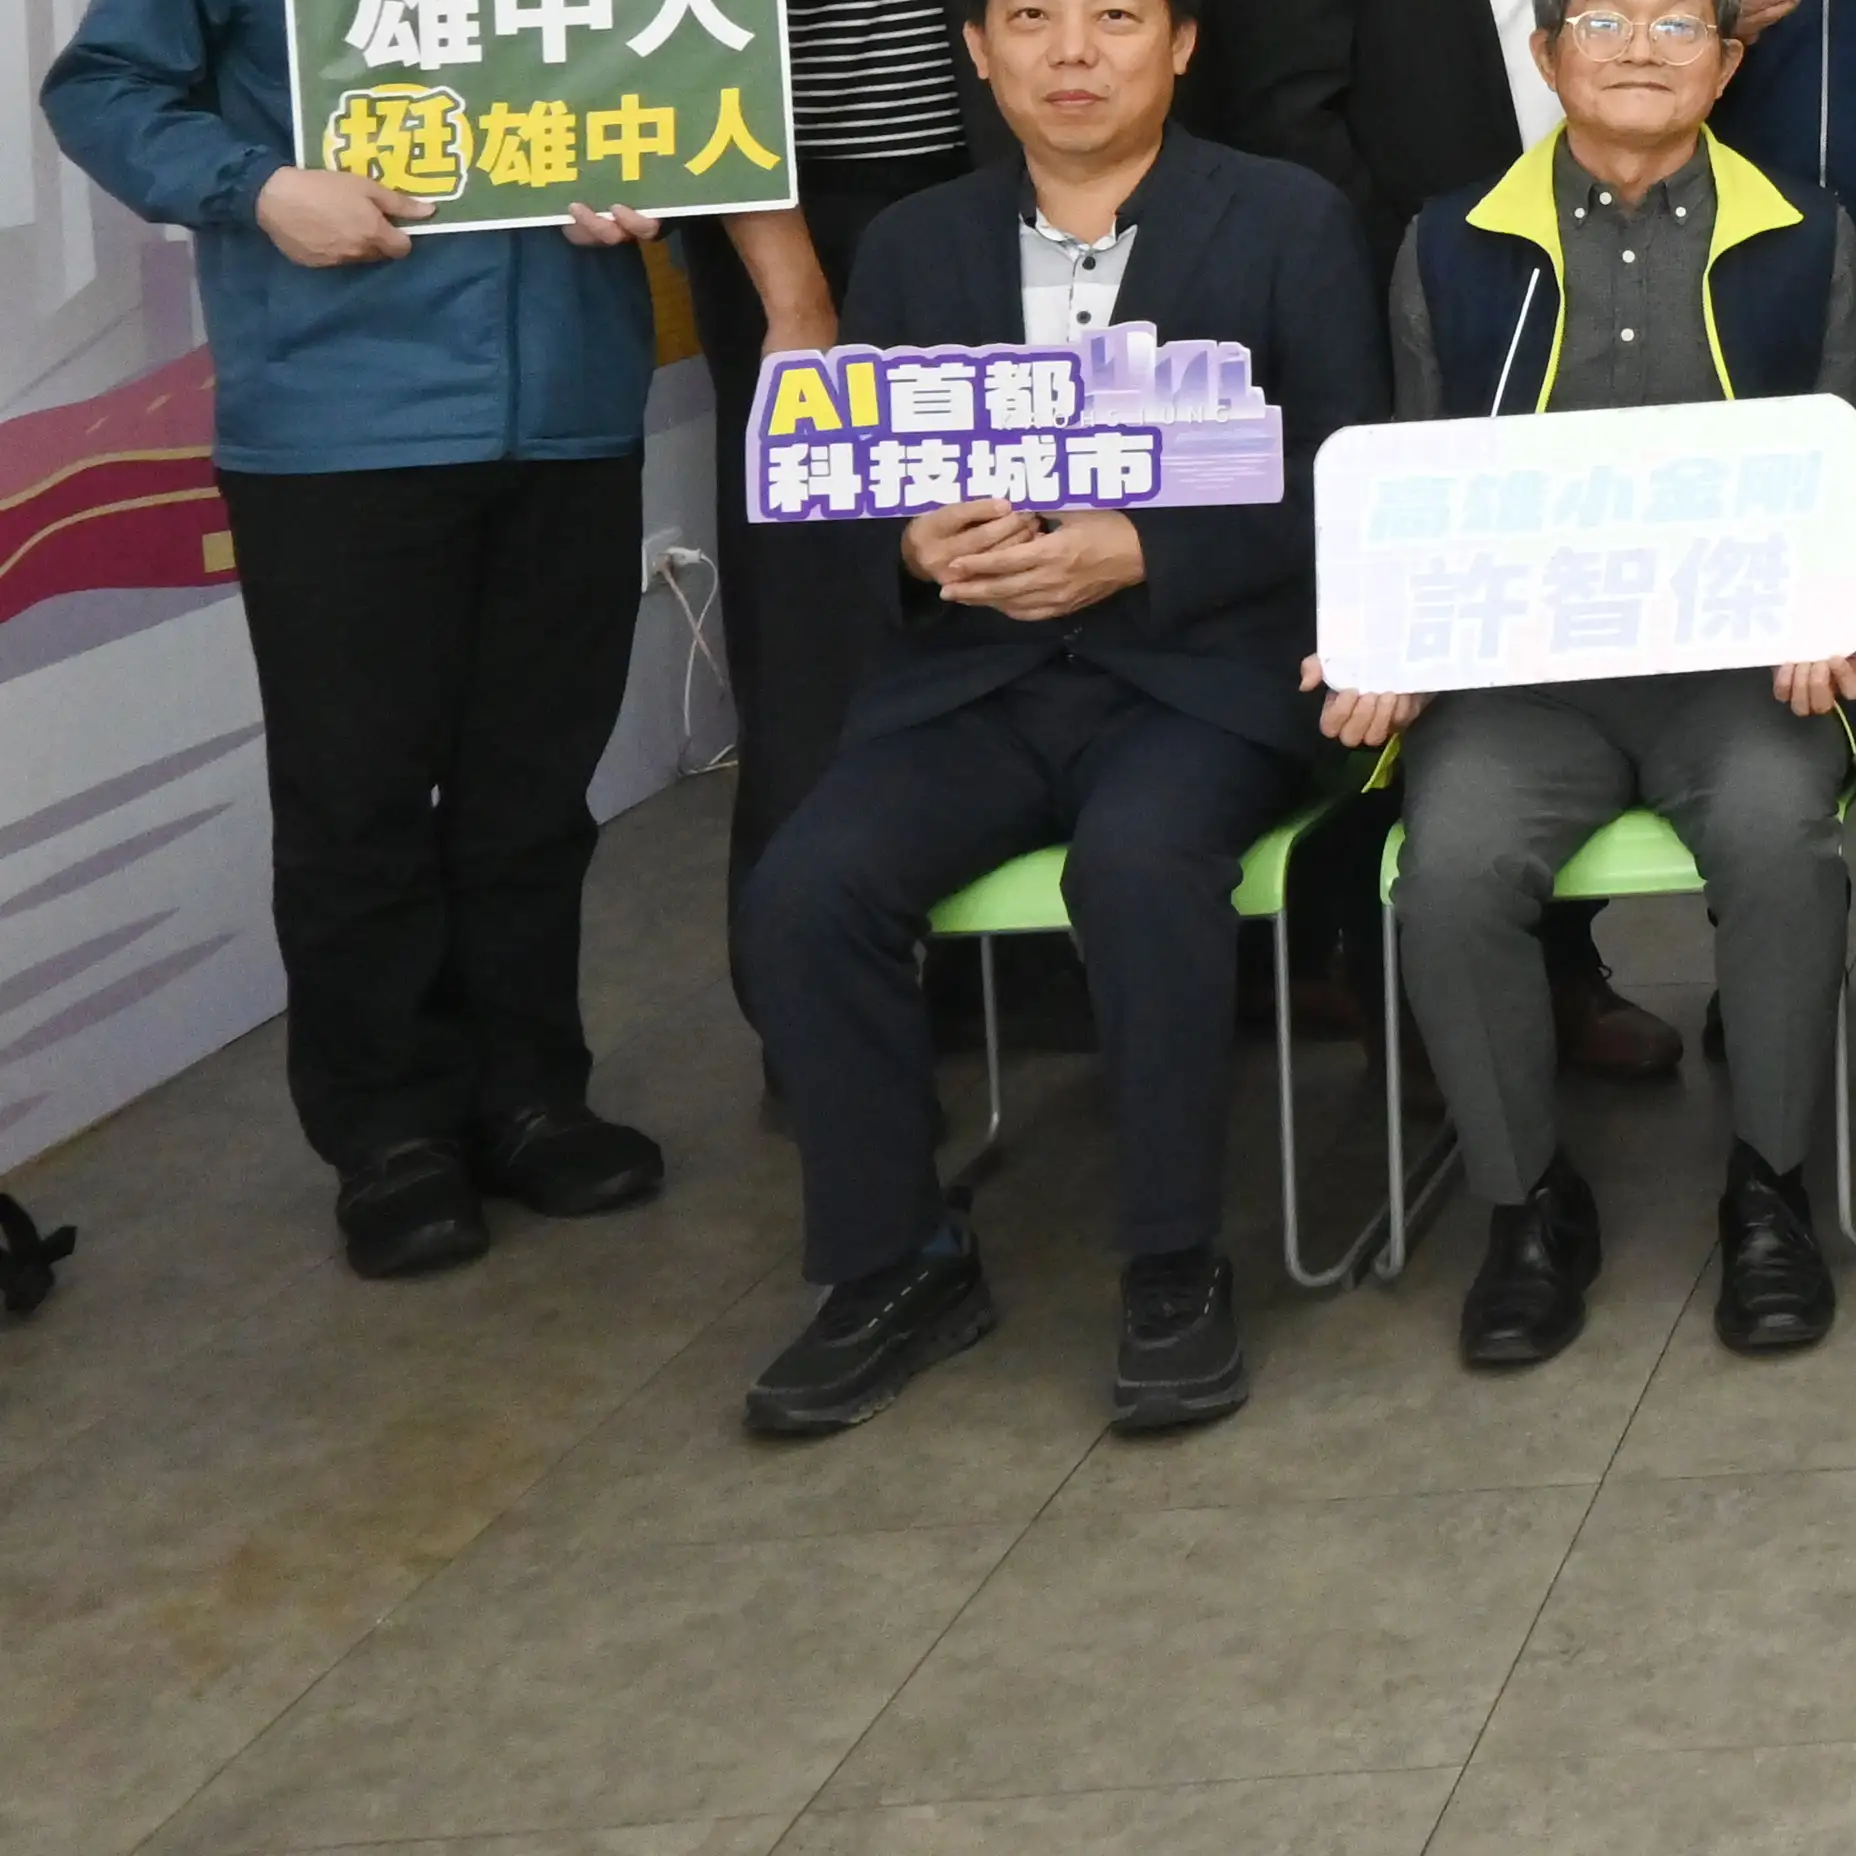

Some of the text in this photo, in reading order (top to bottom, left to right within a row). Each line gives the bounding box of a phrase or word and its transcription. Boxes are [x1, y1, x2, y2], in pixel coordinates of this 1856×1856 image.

[335, 88, 780, 192] 挺雄中人
[767, 360, 1078, 436] AI首都
[767, 433, 1155, 513] 科技城市
[1406, 532, 1792, 664] 許智傑
